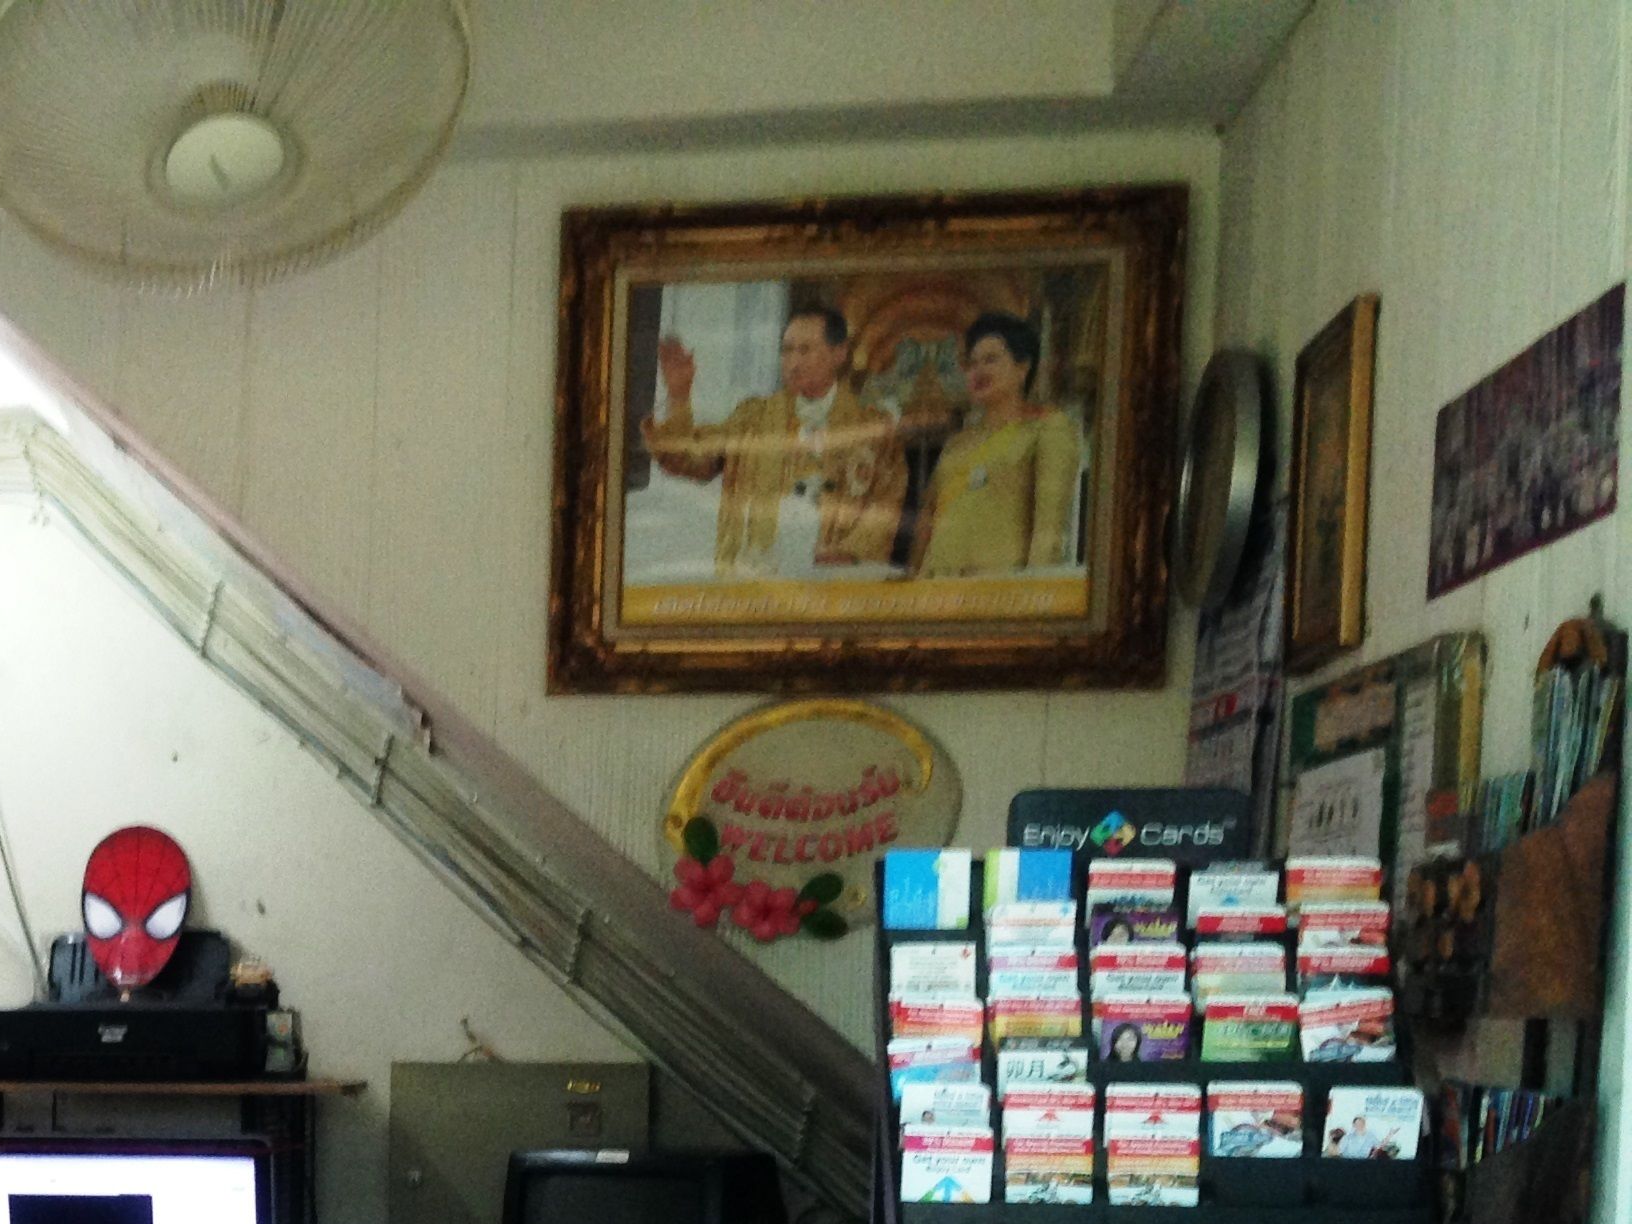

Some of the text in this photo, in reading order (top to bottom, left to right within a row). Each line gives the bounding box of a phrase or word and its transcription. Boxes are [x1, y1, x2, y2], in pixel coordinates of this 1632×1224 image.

[720, 811, 899, 864] WELCOME
[1023, 819, 1225, 850] Enjoy Cards
